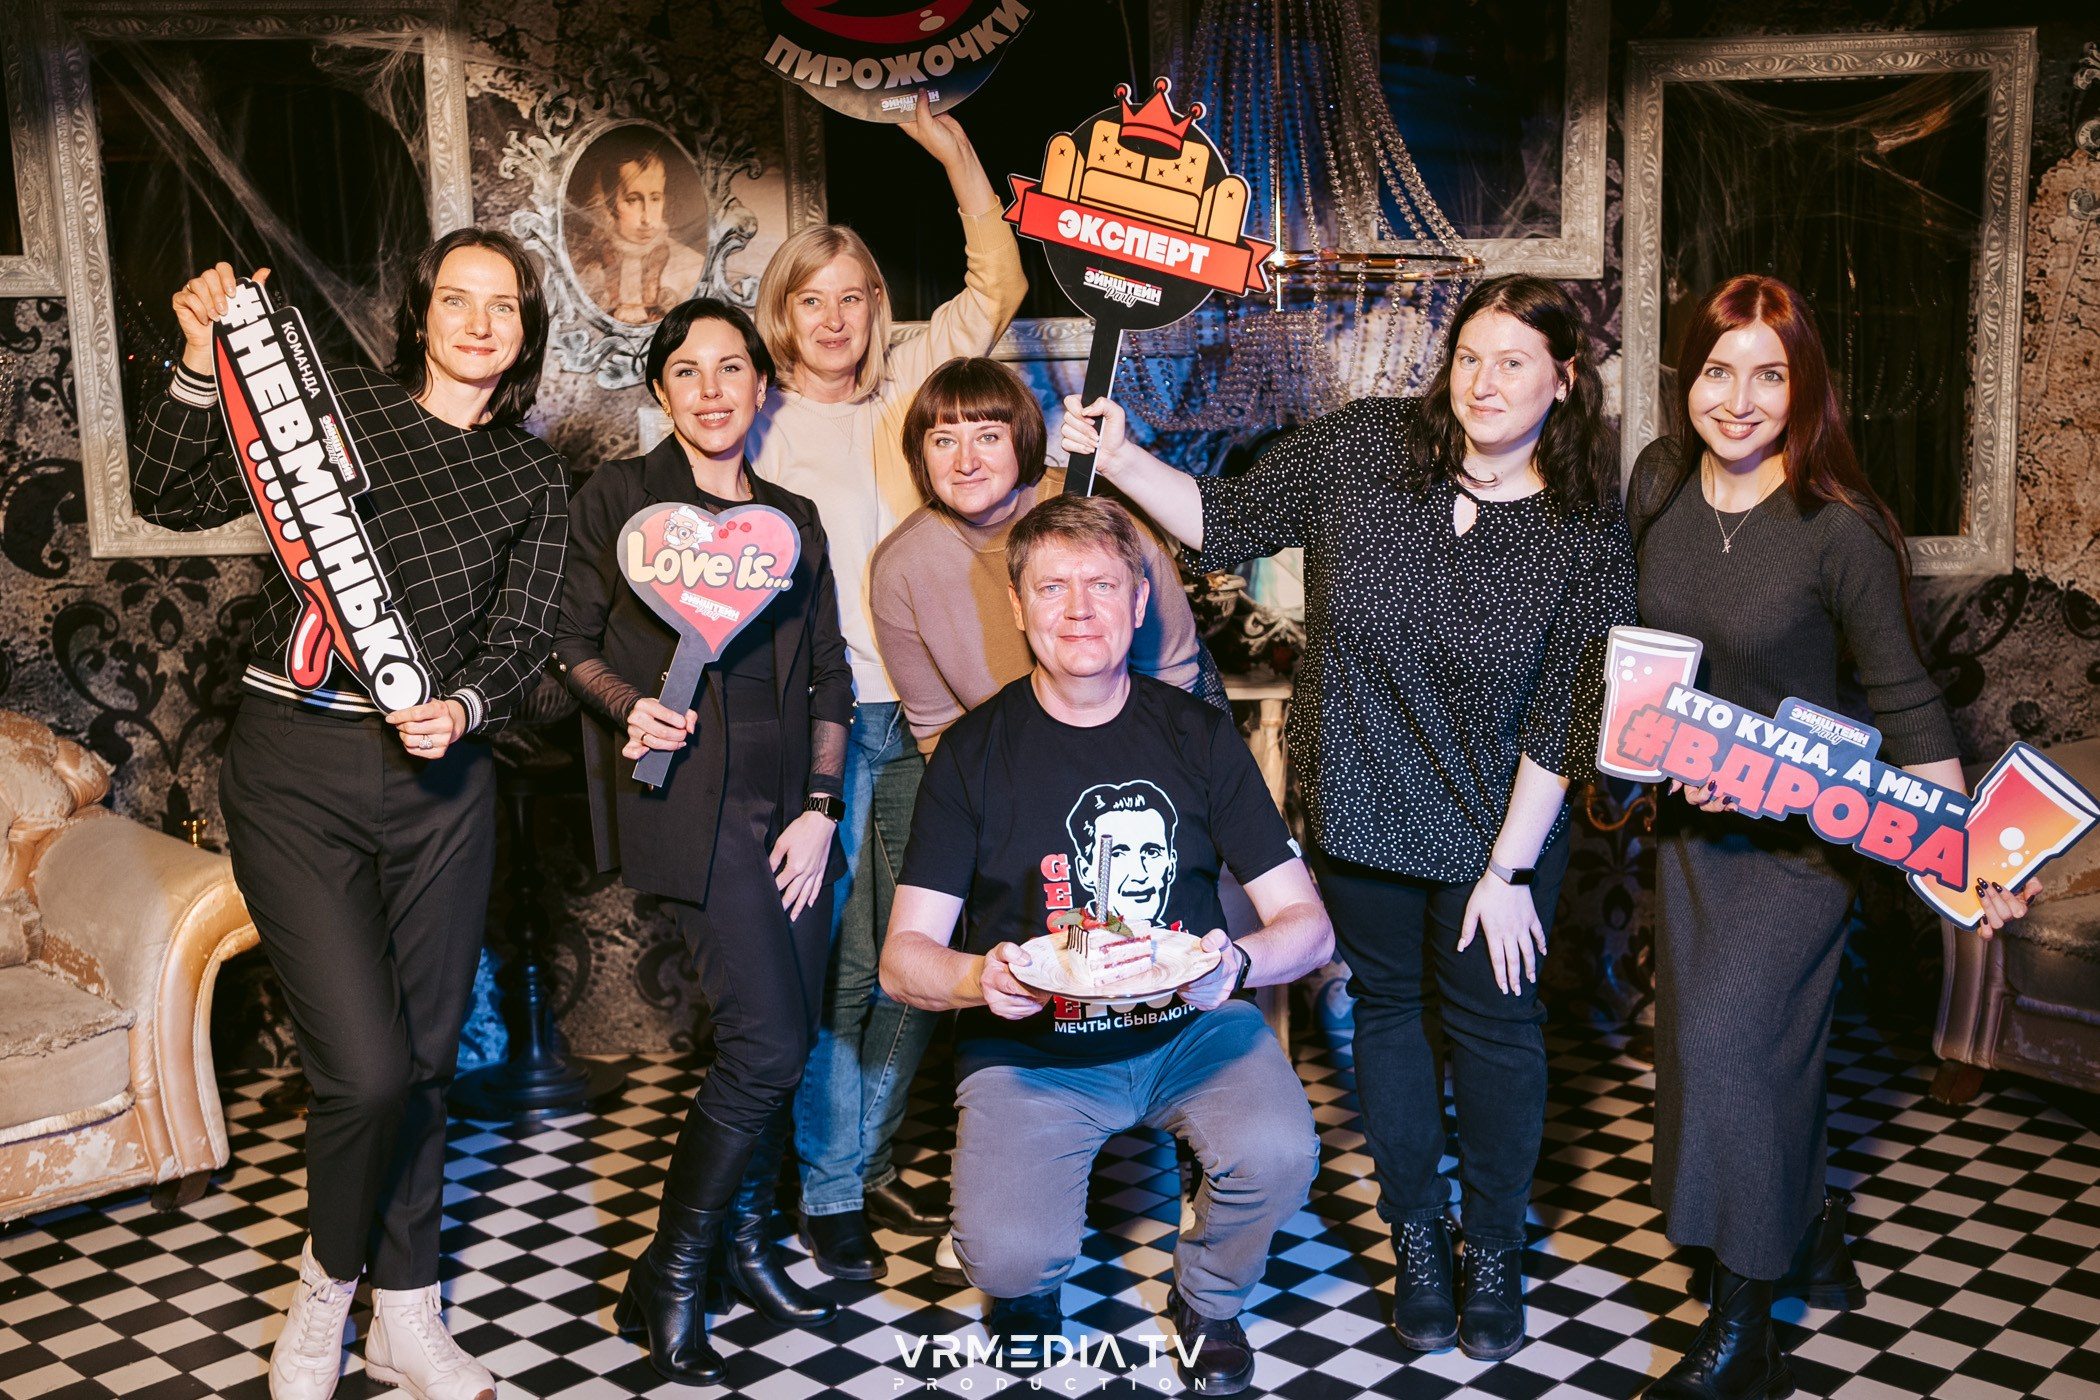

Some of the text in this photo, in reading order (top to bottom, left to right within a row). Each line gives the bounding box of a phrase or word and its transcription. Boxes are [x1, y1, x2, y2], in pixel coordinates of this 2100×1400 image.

[764, 0, 1030, 90] ПИРОЖОЧКИ
[1057, 209, 1210, 274] ЭКСПЕРТ
[1084, 269, 1162, 303] ЭЙНШТЕЙН
[1104, 285, 1138, 308] Party
[281, 321, 321, 399] КОМАНДА
[627, 531, 790, 589] Love is...
[1666, 687, 1733, 729] КТО
[1735, 714, 1837, 777] КУДА,
[1843, 759, 1872, 787] А
[1877, 768, 1943, 814] МЫ
[1791, 707, 1870, 746] ЭЙНШТЕЙН
[1621, 708, 1966, 888] #ВДРОВА
[1054, 1018, 1111, 1034] МЕЧТЫ
